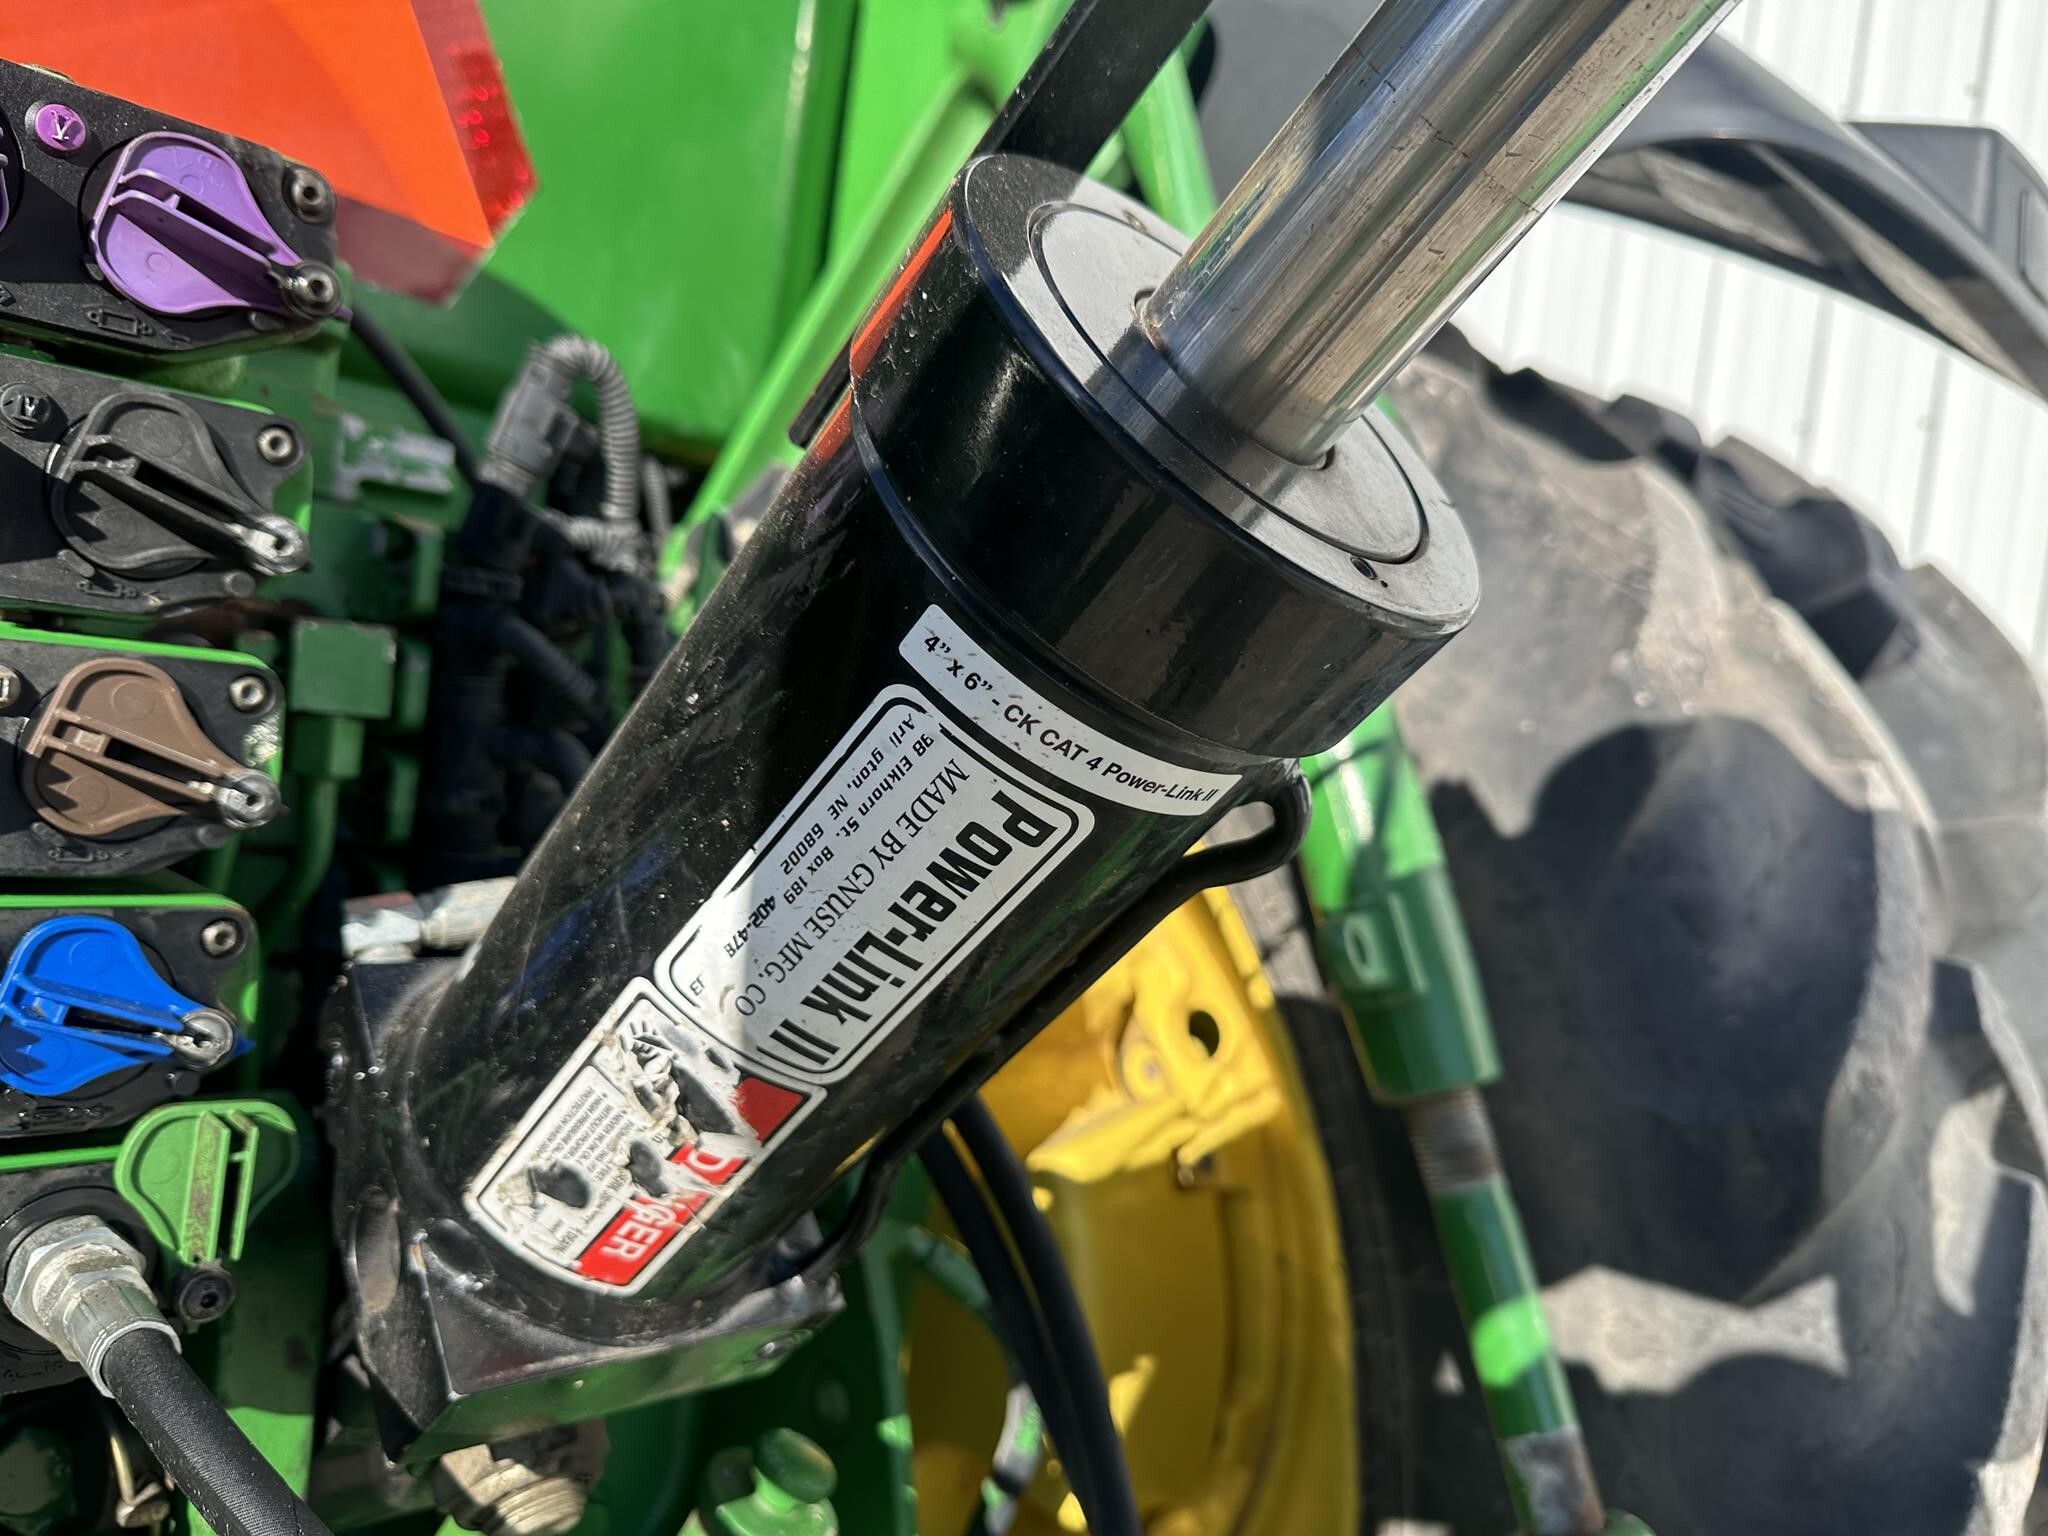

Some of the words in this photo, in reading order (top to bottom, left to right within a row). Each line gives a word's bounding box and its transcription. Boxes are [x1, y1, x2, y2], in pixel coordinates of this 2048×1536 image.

[946, 659, 964, 678] x
[1004, 704, 1042, 736] CK
[1040, 729, 1089, 763] CAT
[1086, 756, 1104, 771] 4
[1101, 762, 1202, 802] Power-Link
[1202, 788, 1219, 802] II
[827, 794, 850, 821] NE
[857, 756, 913, 817] Elkhorn
[896, 758, 970, 838] MADE
[780, 823, 825, 876] 68002
[835, 812, 860, 838] St.
[807, 846, 834, 876] Box
[875, 833, 906, 872] BY
[783, 875, 808, 905] 189
[800, 790, 1058, 1025] Power-Link
[803, 863, 875, 940] GNUSE
[735, 984, 766, 1017] CO
[769, 1018, 841, 1066] II
[600, 1151, 729, 1261] DGER
